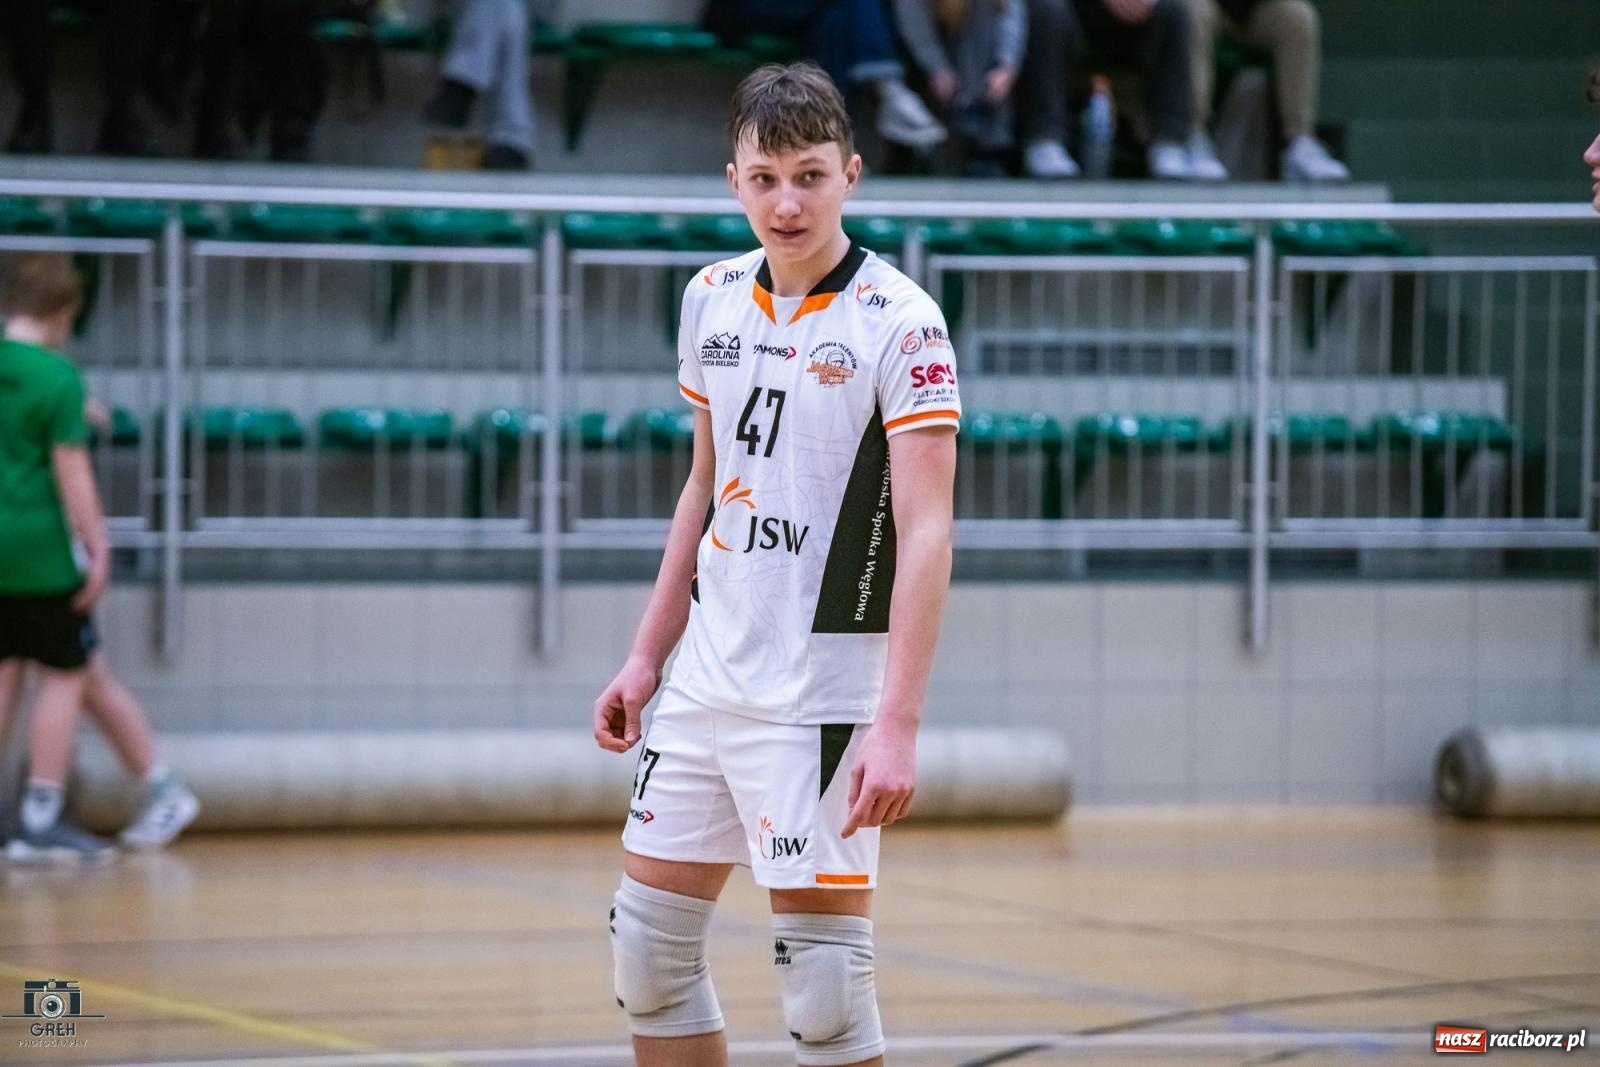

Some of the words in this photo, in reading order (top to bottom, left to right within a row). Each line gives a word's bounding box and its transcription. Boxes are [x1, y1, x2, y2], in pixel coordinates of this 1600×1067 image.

[701, 350, 740, 360] CAROLINA
[736, 386, 787, 458] 47
[743, 515, 810, 556] JSW
[854, 560, 877, 621] Węglowa
[633, 744, 660, 800] 7
[771, 837, 808, 860] JSW
